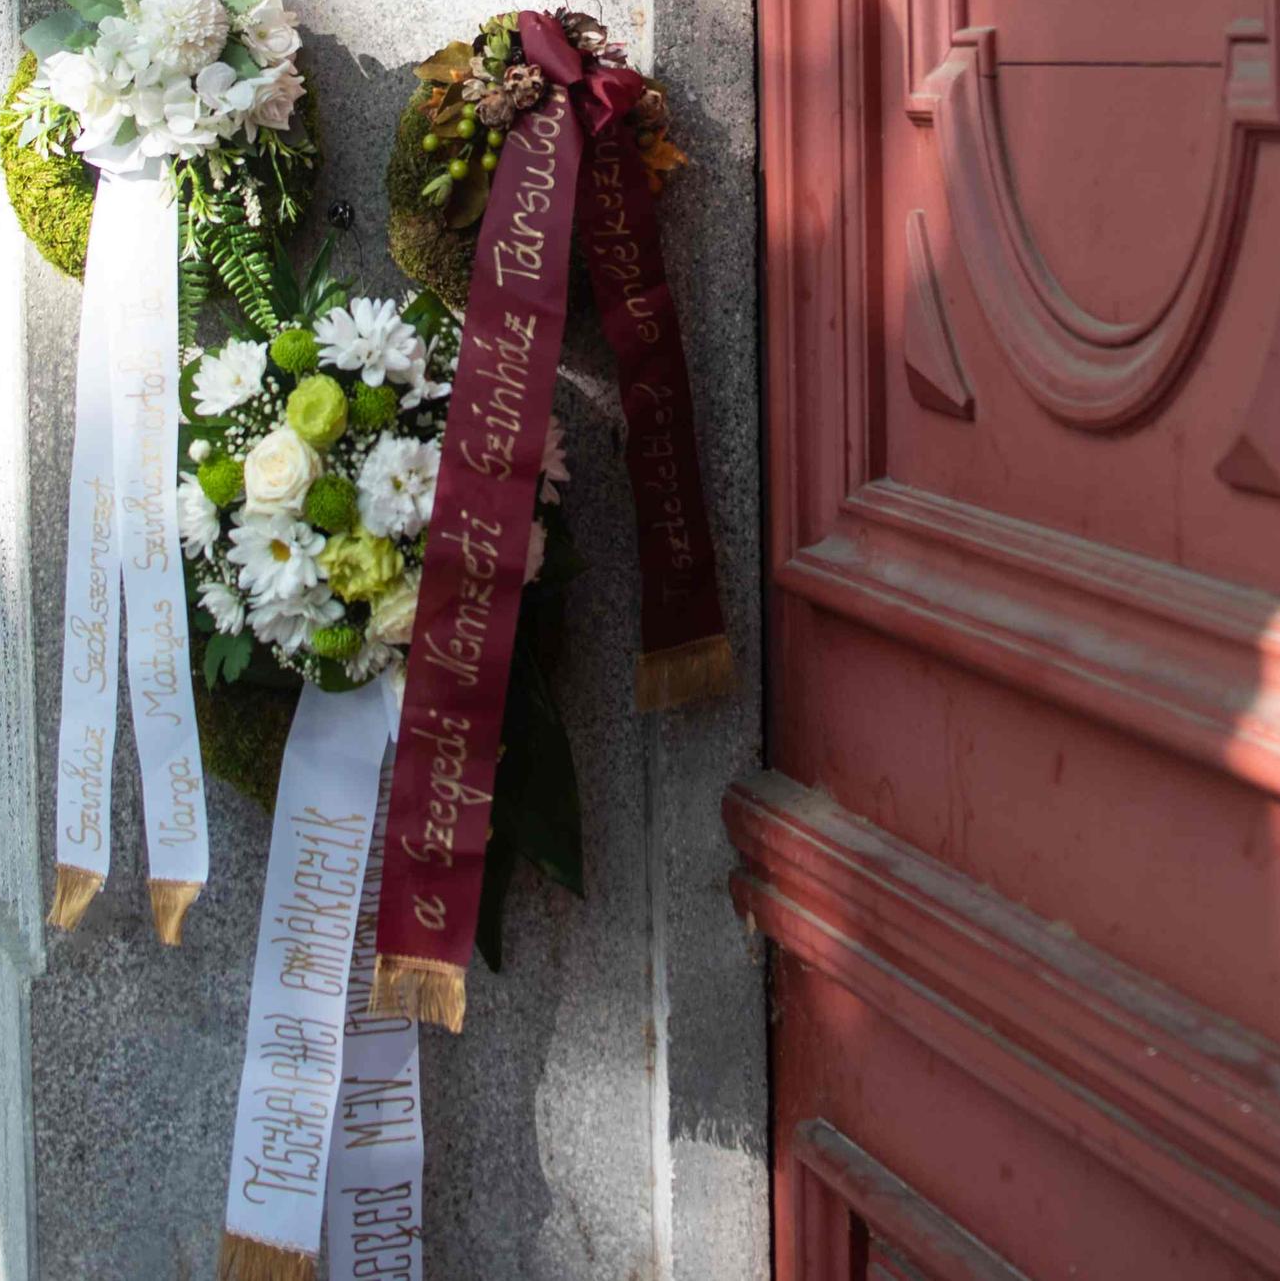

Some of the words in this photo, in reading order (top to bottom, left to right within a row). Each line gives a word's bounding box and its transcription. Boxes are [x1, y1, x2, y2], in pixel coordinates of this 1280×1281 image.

[492, 84, 567, 287] Társula
[459, 309, 538, 482] Színház
[140, 598, 184, 727] Mátyás
[422, 509, 503, 686] Nemzeti
[61, 726, 103, 852] Színház
[158, 756, 200, 848] Varga
[400, 707, 493, 867] Szegedi
[269, 804, 367, 997] emlékezik
[411, 892, 447, 932] a
